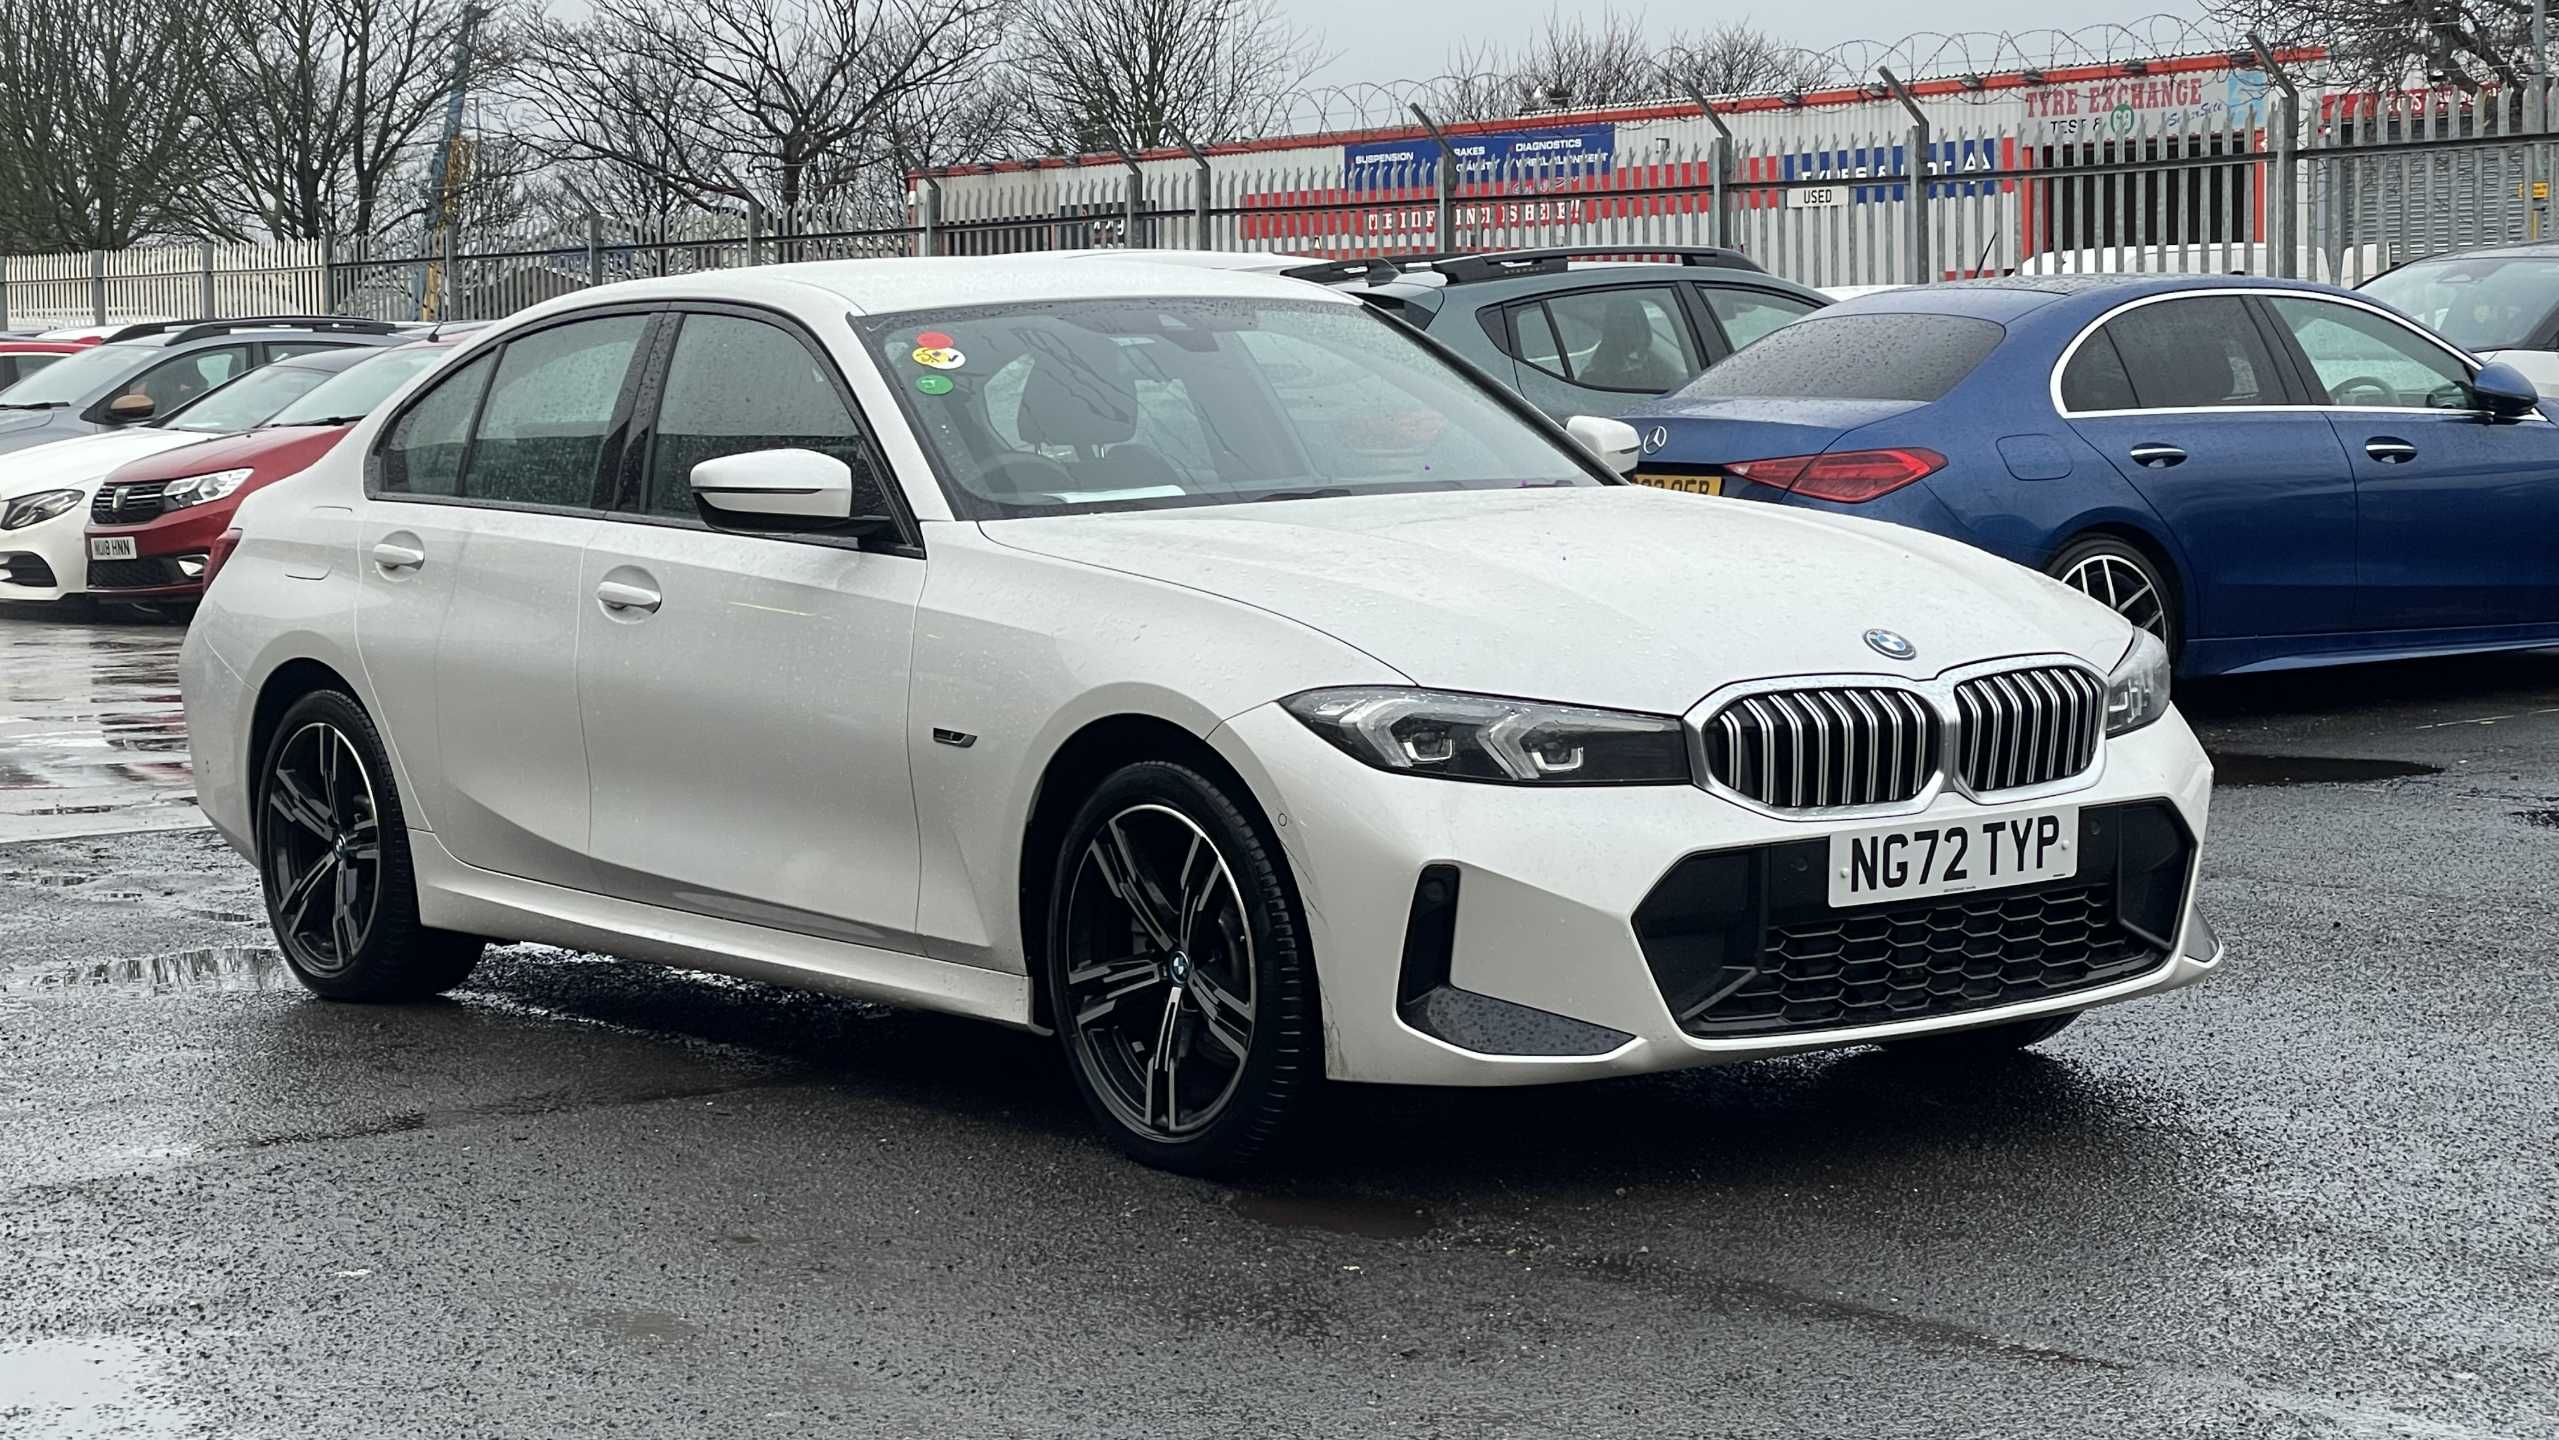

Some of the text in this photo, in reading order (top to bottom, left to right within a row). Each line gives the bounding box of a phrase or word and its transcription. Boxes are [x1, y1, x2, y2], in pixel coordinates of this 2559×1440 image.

[2026, 78, 2202, 118] TYRE EXCHANGE
[1454, 146, 1485, 157] RAKES
[1516, 138, 1582, 152] DIAGNOSTICS
[1355, 152, 1414, 164] SUSPENSION
[1803, 188, 1833, 204] USED
[1850, 815, 2059, 893] NG72 TYP
